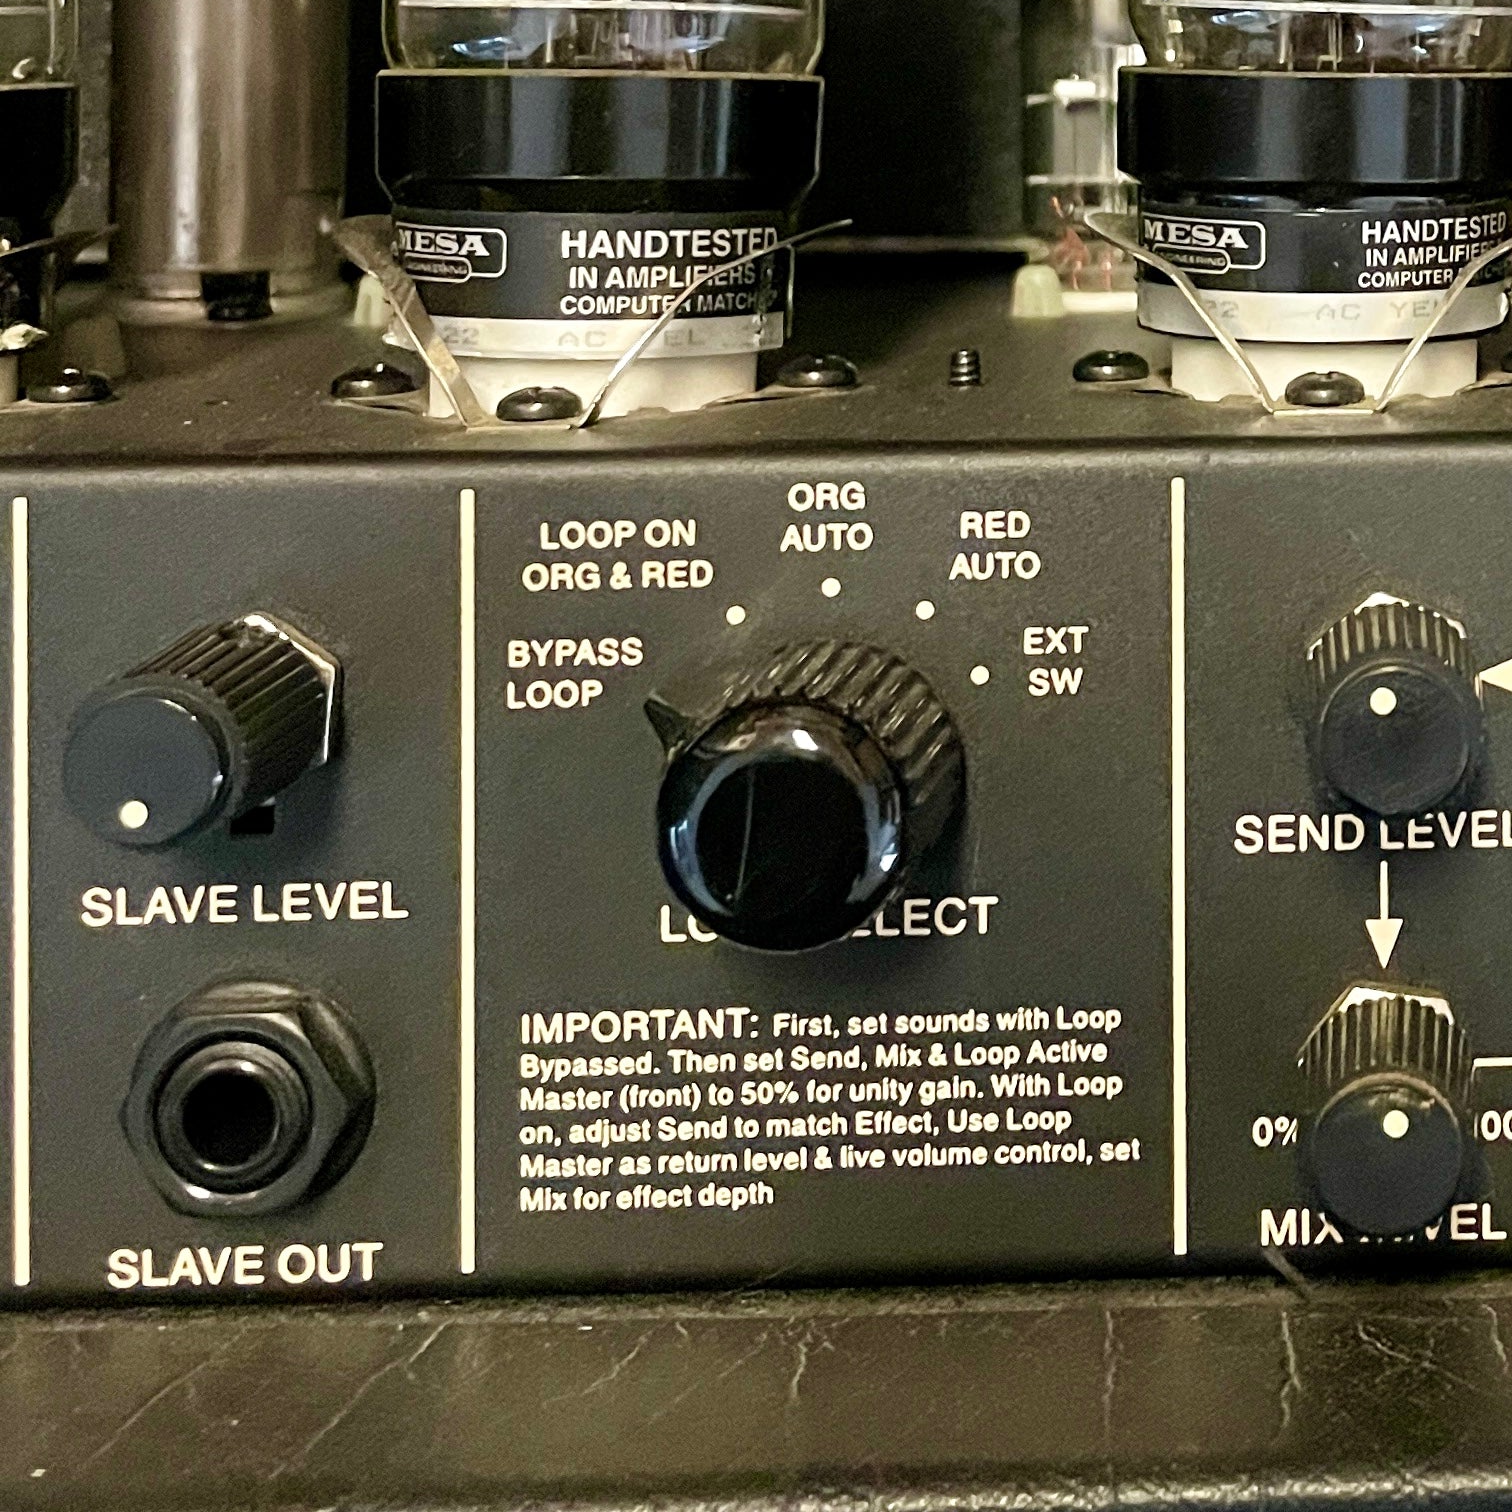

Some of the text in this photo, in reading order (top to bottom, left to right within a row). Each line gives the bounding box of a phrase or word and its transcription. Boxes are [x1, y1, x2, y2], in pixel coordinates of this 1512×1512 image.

[561, 227, 777, 258] HANDTESTED
[1144, 218, 1249, 249] MESA
[1361, 211, 1507, 244] HANDTESTED
[1365, 248, 1388, 267] IN
[569, 266, 598, 289] IN
[1358, 268, 1453, 288] COMPUTER
[788, 481, 865, 512] ORG
[540, 519, 696, 550] LOOP ON
[780, 523, 873, 552] AUTO
[960, 511, 1030, 539] RED
[522, 560, 713, 591] ORG & RED
[949, 551, 1041, 580] AUTO
[508, 637, 643, 668] BYPASS
[1024, 626, 1089, 654] EXT
[507, 679, 603, 709] LOOP
[1029, 668, 1083, 696] SW
[1234, 814, 1364, 854] SEND
[81, 881, 409, 927] SLAVE LEVEL
[852, 896, 999, 937] LECT
[522, 1006, 1121, 1044] IMPORTANT: First, set sounds with Loop
[520, 1039, 1107, 1083] Bypassed. Then set Send, Mix & Loop Active
[520, 1073, 1122, 1113] Master (front) to 50% for unity gain. With Loop
[519, 1107, 1071, 1148] on, adjust Send to match Effect, Use Loop
[520, 1138, 1140, 1178] Master as return level & live volume control, set
[520, 1182, 773, 1211] Mix for effect depth
[107, 1243, 383, 1288] SLAVE OUT
